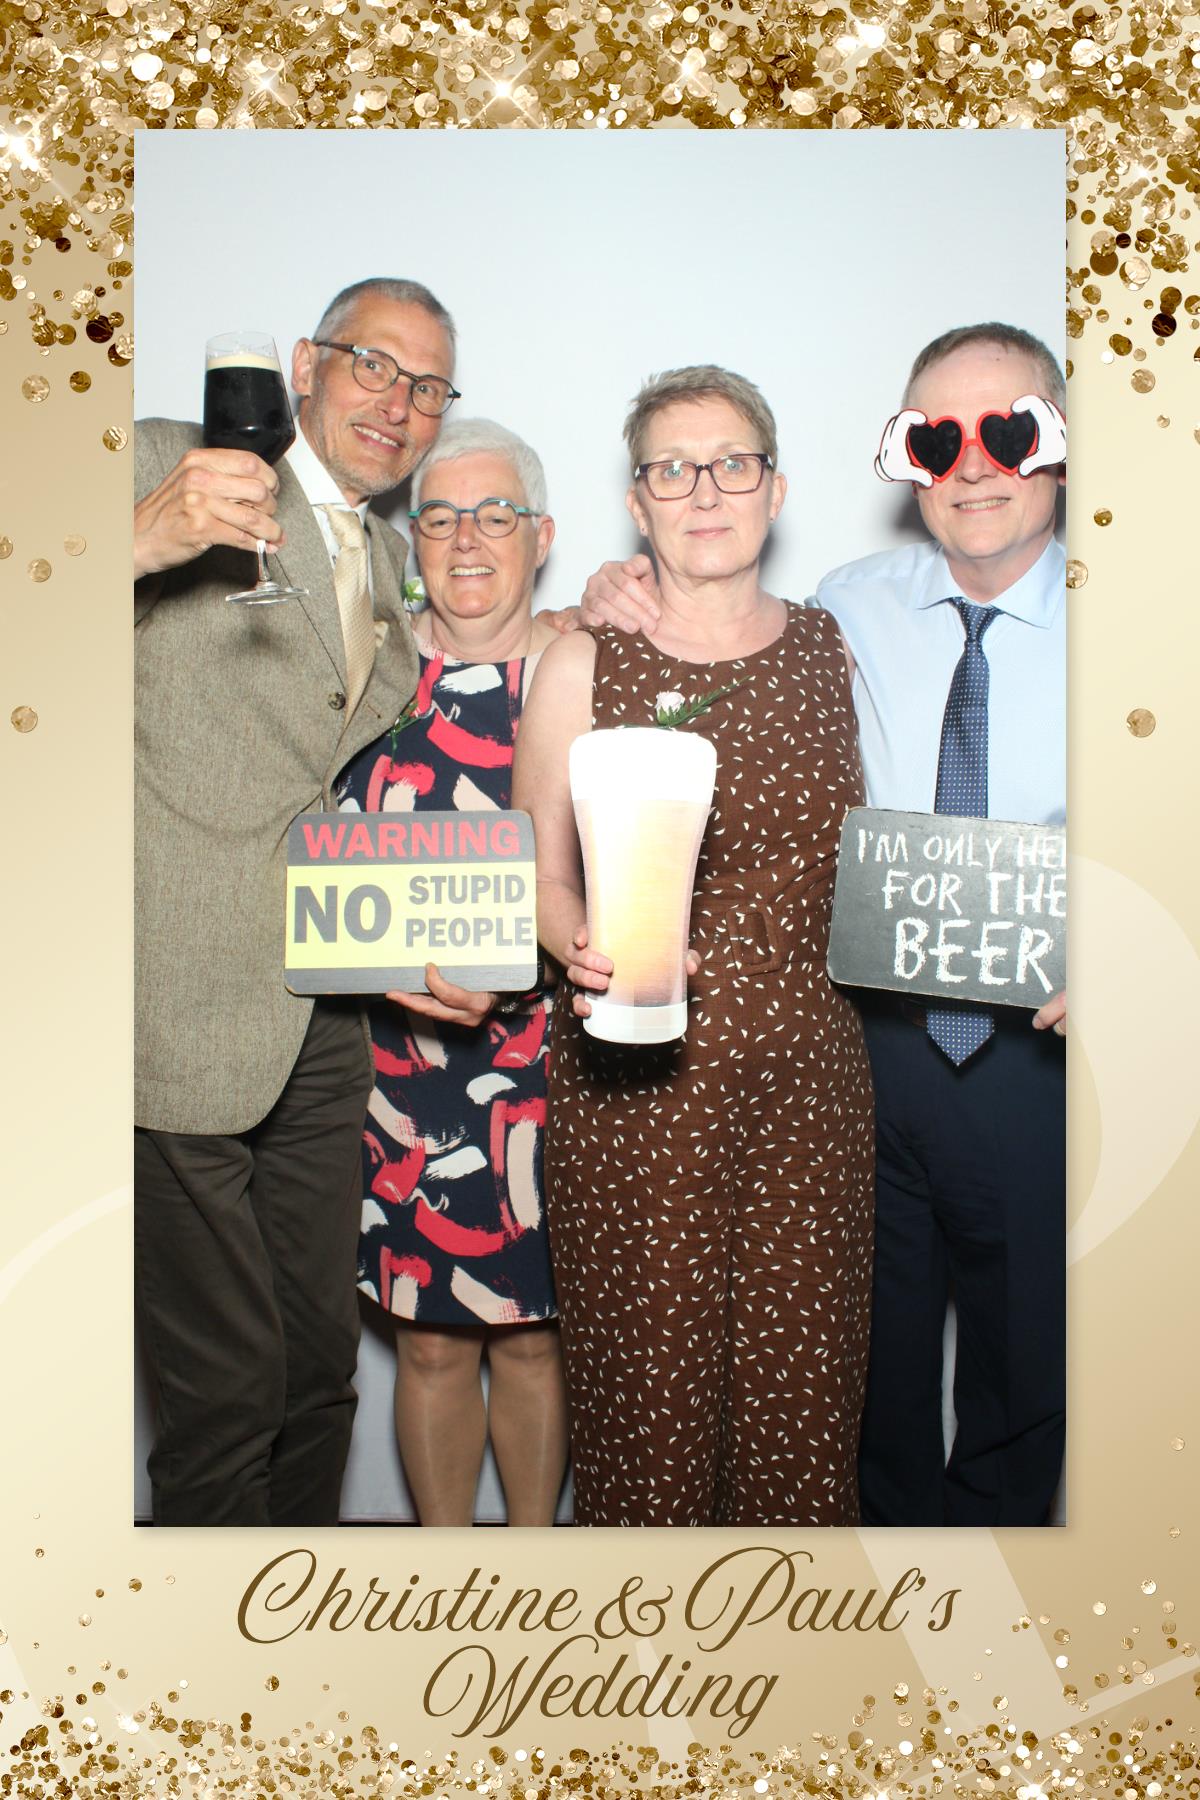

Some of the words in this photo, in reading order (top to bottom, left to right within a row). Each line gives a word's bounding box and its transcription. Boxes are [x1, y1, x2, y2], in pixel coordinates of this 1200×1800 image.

[303, 819, 521, 859] WARNING
[857, 828, 908, 863] I'M
[923, 832, 1001, 871] ONLY
[1016, 835, 1066, 868] HE
[408, 874, 526, 905] STUPID
[881, 868, 963, 916] FOR
[986, 871, 1066, 918] THE
[293, 883, 392, 943] NO
[405, 916, 534, 948] PEOPLE
[894, 917, 1054, 994] BEER
